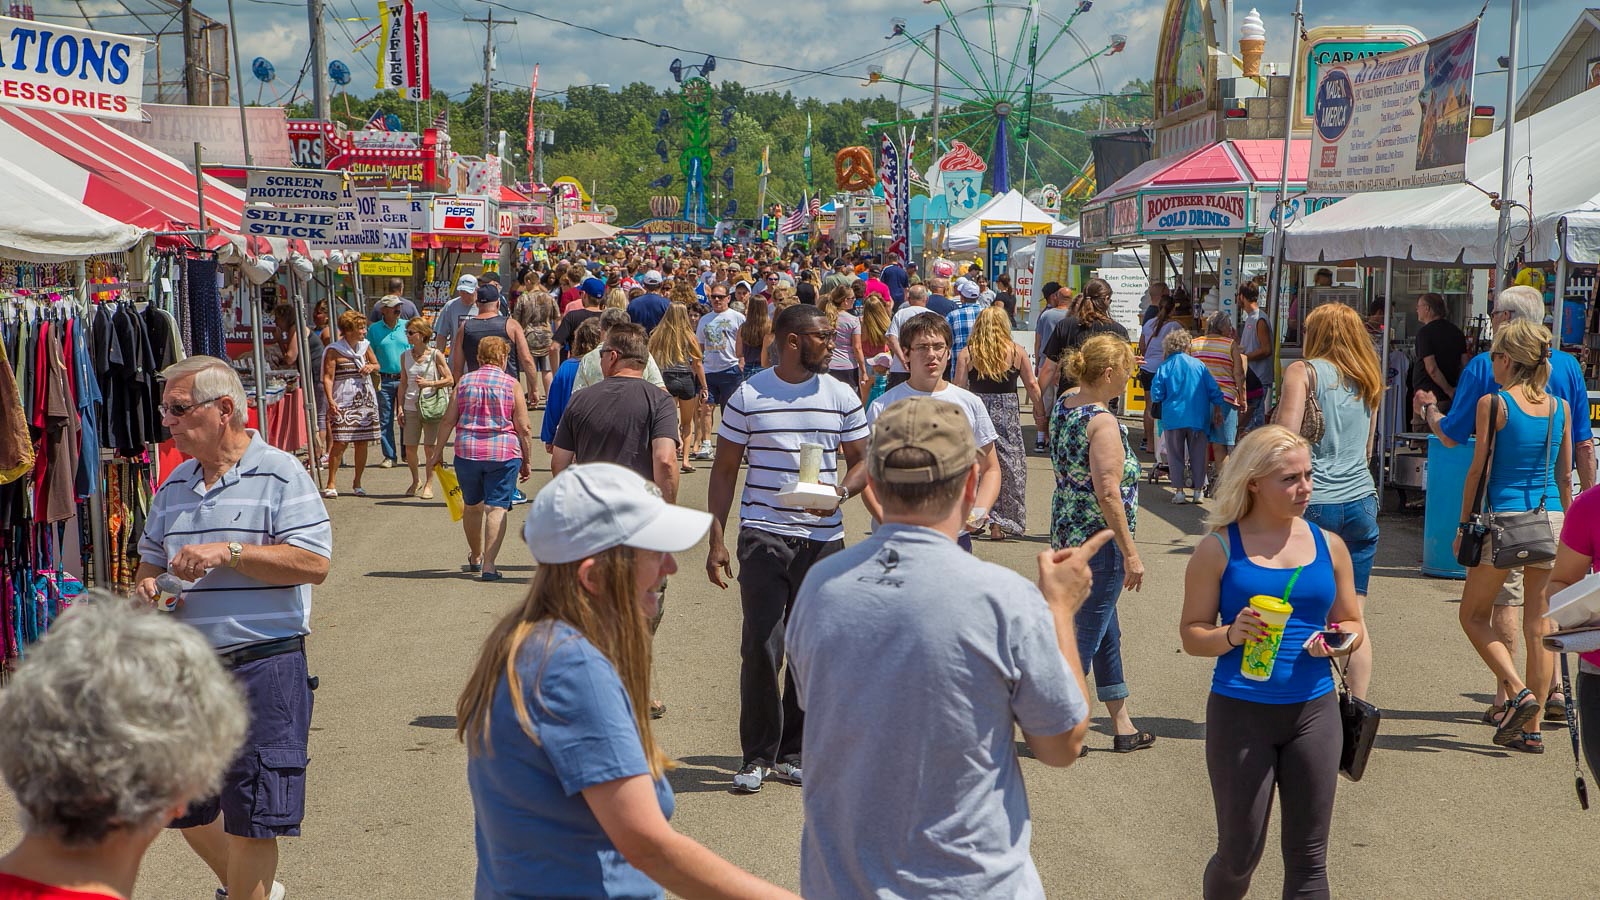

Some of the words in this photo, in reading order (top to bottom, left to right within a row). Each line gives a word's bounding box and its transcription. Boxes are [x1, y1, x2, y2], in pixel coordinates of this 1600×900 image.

[389, 5, 403, 86] WAFFLES
[0, 80, 127, 113] ESSORIES
[1321, 105, 1346, 128] AMERICA
[266, 176, 324, 188] SCREEN
[250, 187, 338, 200] PROTECTORS
[446, 207, 475, 216] PEPSI
[1147, 195, 1204, 223] ROOTBEER
[1206, 195, 1244, 220] FLOATS
[1304, 197, 1346, 216] IC
[246, 209, 334, 225] SELFIE
[1158, 211, 1187, 227] COLD
[1188, 209, 1231, 227] DRINKS
[249, 224, 326, 239] STICK
[1047, 239, 1074, 247] FRESH
[400, 264, 411, 273] TEA
[1223, 258, 1232, 286] ICE
